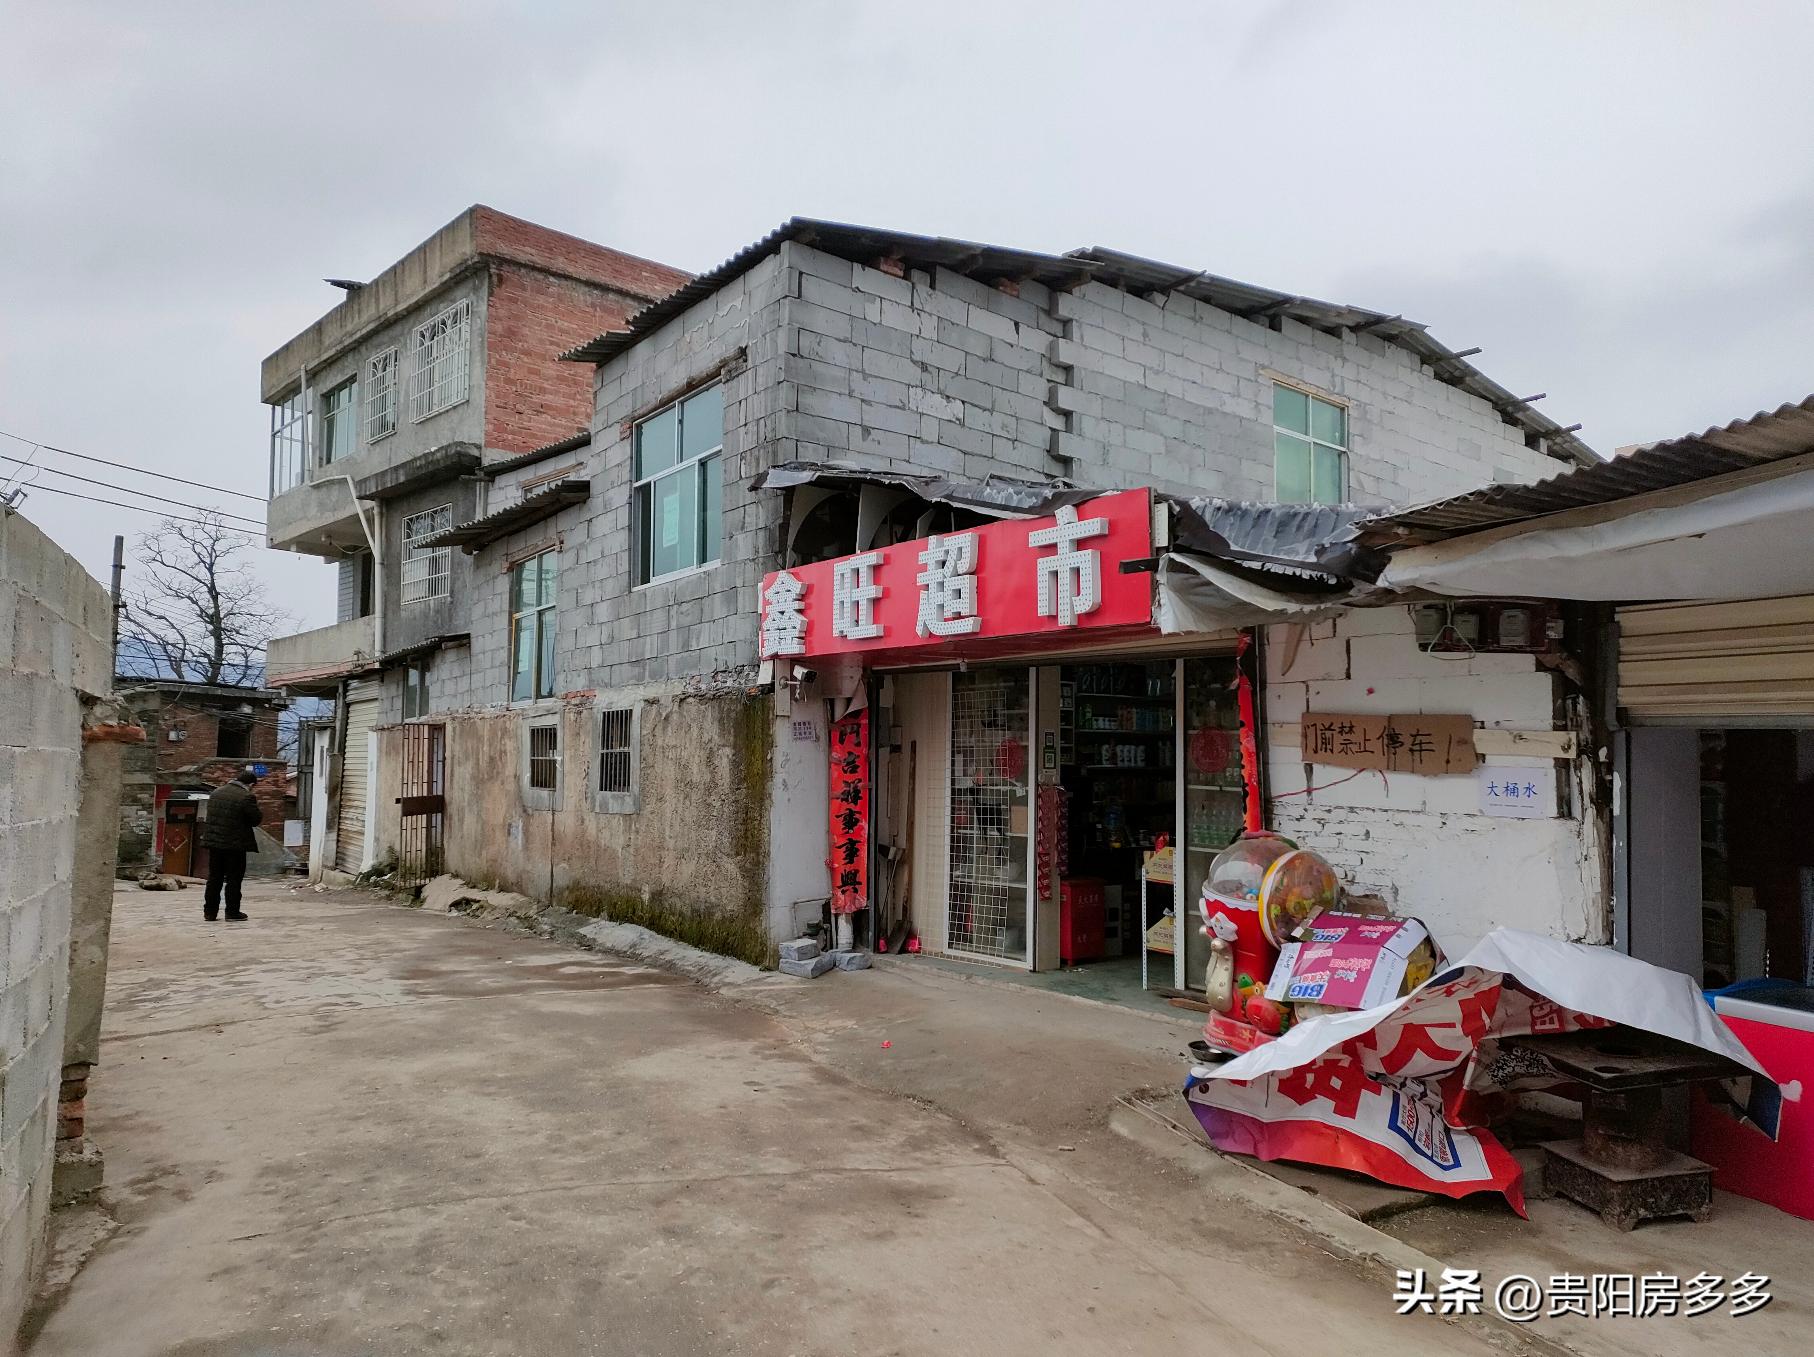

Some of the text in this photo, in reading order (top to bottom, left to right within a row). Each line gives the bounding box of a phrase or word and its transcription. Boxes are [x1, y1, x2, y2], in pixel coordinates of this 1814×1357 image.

[762, 504, 1109, 657] 鑫旺超市
[836, 709, 863, 894] 門吉祥事事興
[1487, 781, 1538, 799] 大桶水
[1289, 984, 1325, 998] BIG
